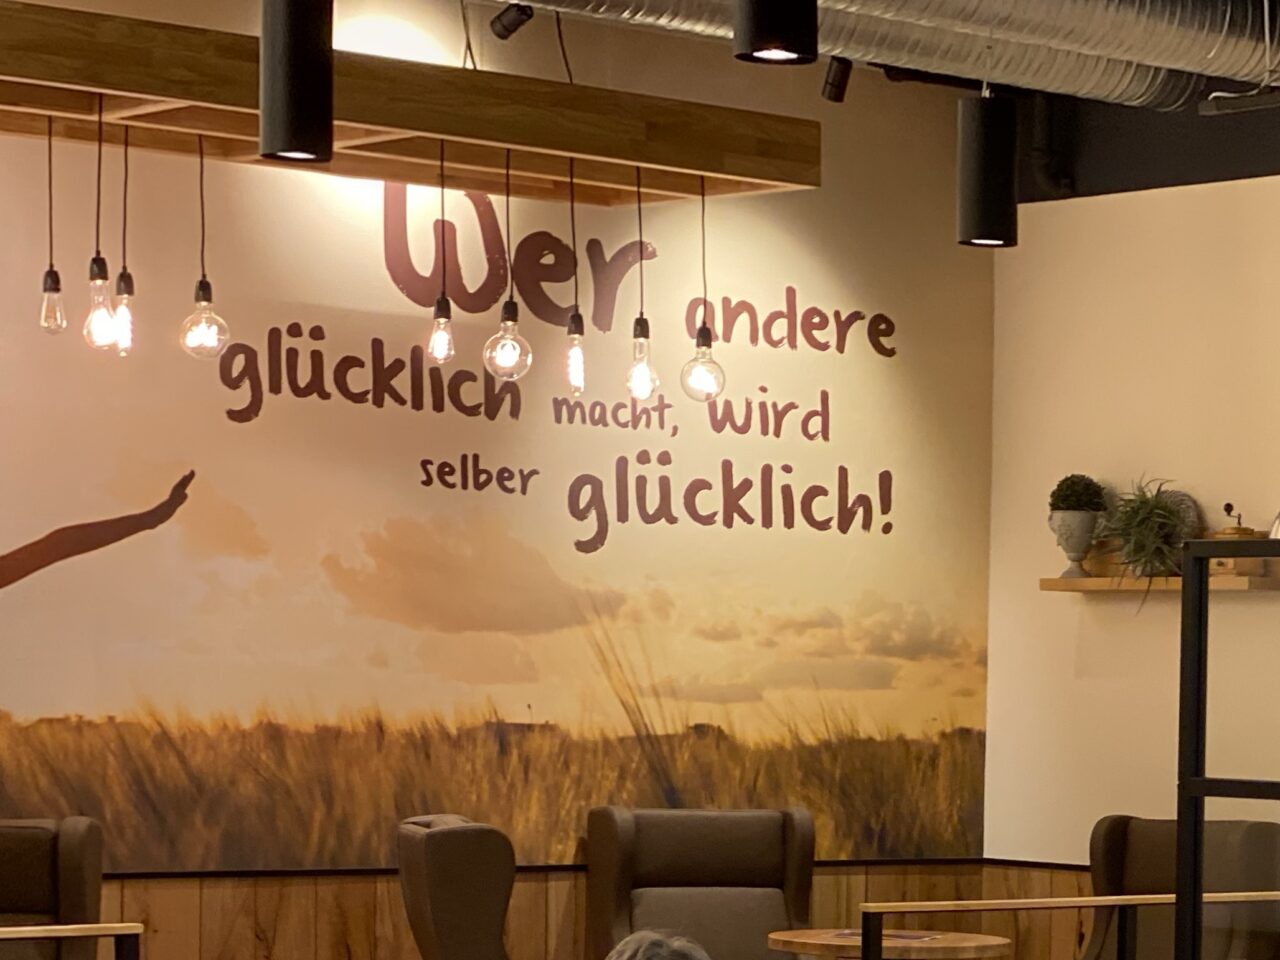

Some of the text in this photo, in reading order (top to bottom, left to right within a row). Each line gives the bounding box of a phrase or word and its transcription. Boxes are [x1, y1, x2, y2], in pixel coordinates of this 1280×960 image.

[384, 180, 897, 358] Wer andere
[219, 323, 830, 441] glücklich macht, wird
[420, 450, 893, 554] selber glücklich!
